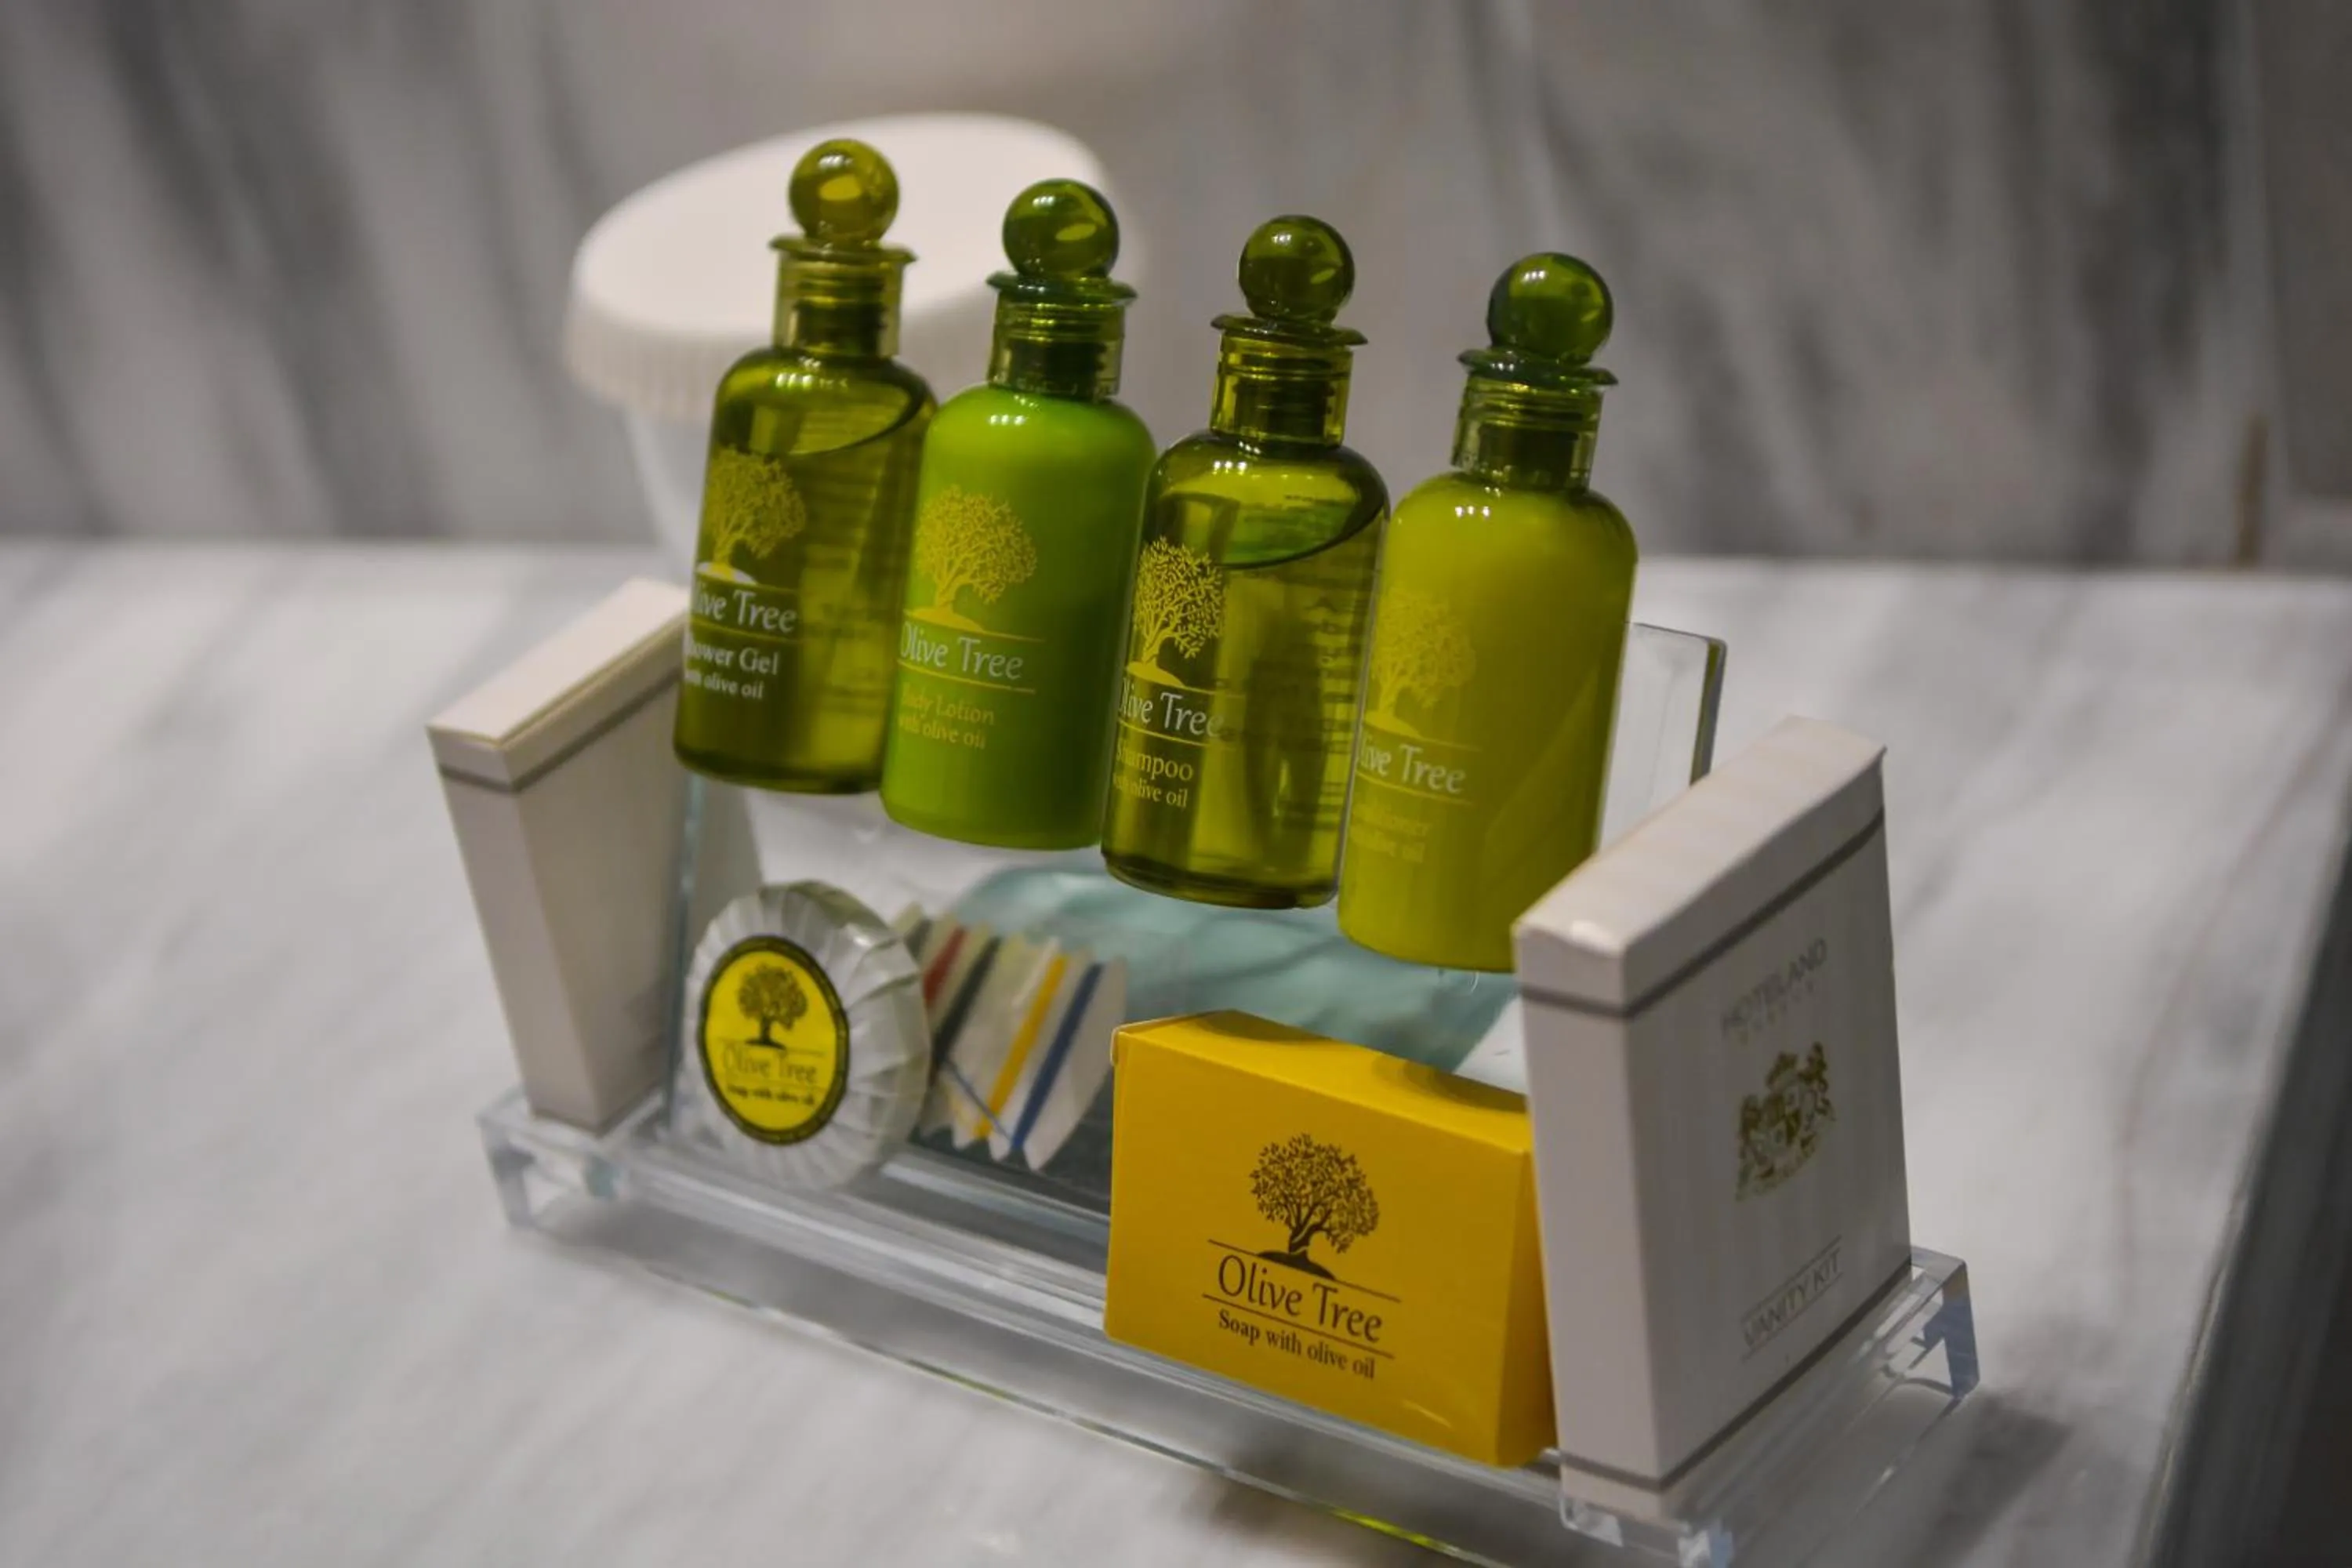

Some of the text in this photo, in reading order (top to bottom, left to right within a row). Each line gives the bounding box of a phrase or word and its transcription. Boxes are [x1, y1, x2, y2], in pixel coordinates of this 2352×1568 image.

[733, 590, 798, 633] Tree
[739, 647, 779, 675] Gel
[957, 636, 1025, 681] Tree
[742, 680, 764, 699] oil
[936, 696, 995, 726] Lotion
[1160, 691, 1225, 738] Tree
[1399, 743, 1467, 794] Tree
[1166, 787, 1188, 808] oil
[1218, 1254, 1383, 1344] Olive Tree
[1218, 1308, 1376, 1380] Soap with olive oil
